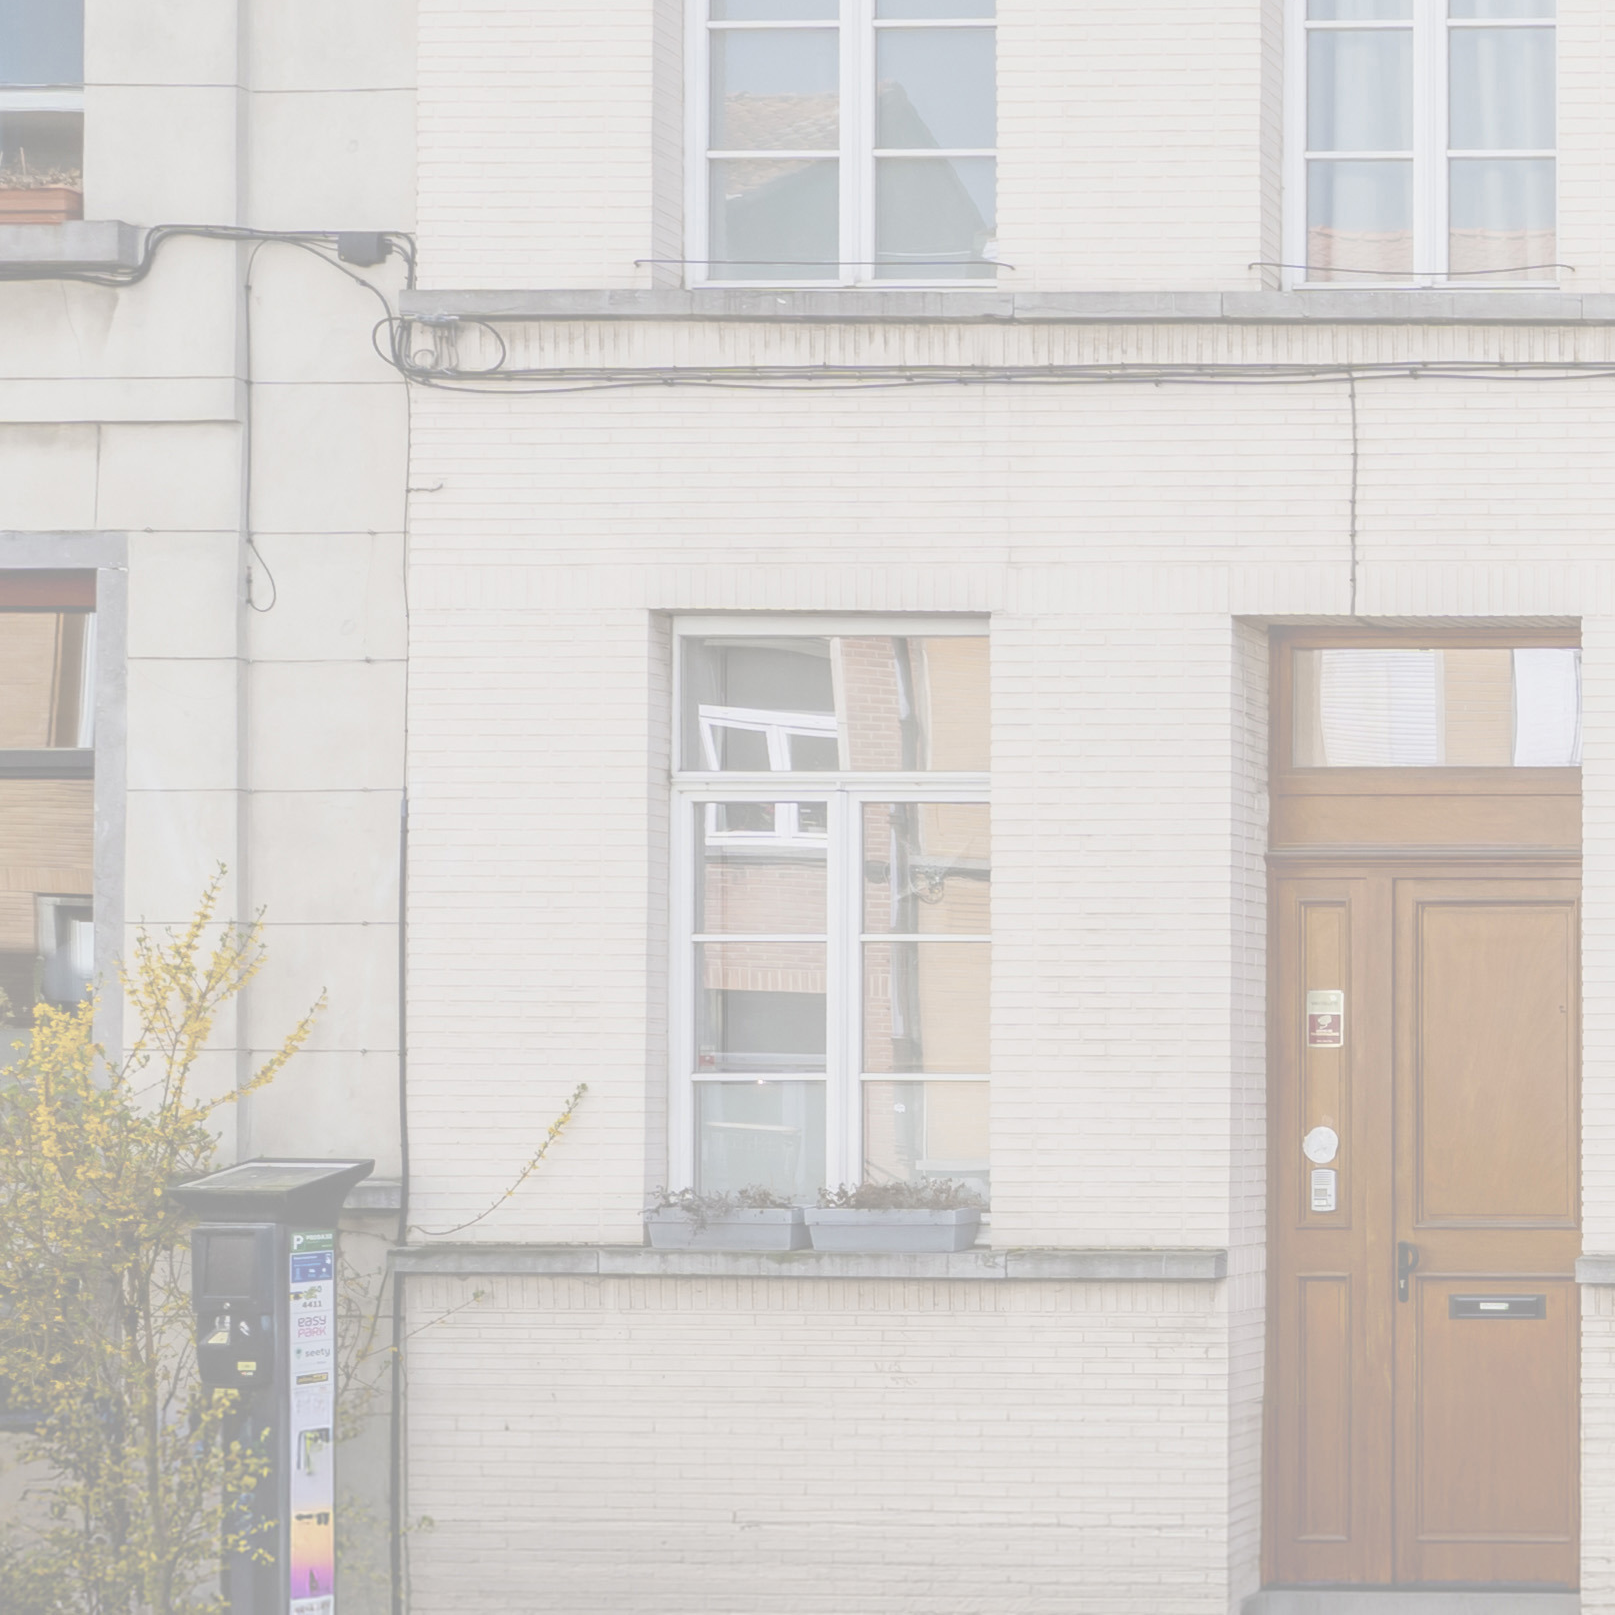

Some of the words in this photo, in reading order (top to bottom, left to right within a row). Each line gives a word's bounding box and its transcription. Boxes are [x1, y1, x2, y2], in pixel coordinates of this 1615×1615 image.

[293, 1234, 304, 1250] P
[302, 1300, 323, 1308] 4411
[297, 1315, 327, 1328] easy
[305, 1347, 330, 1358] seety
